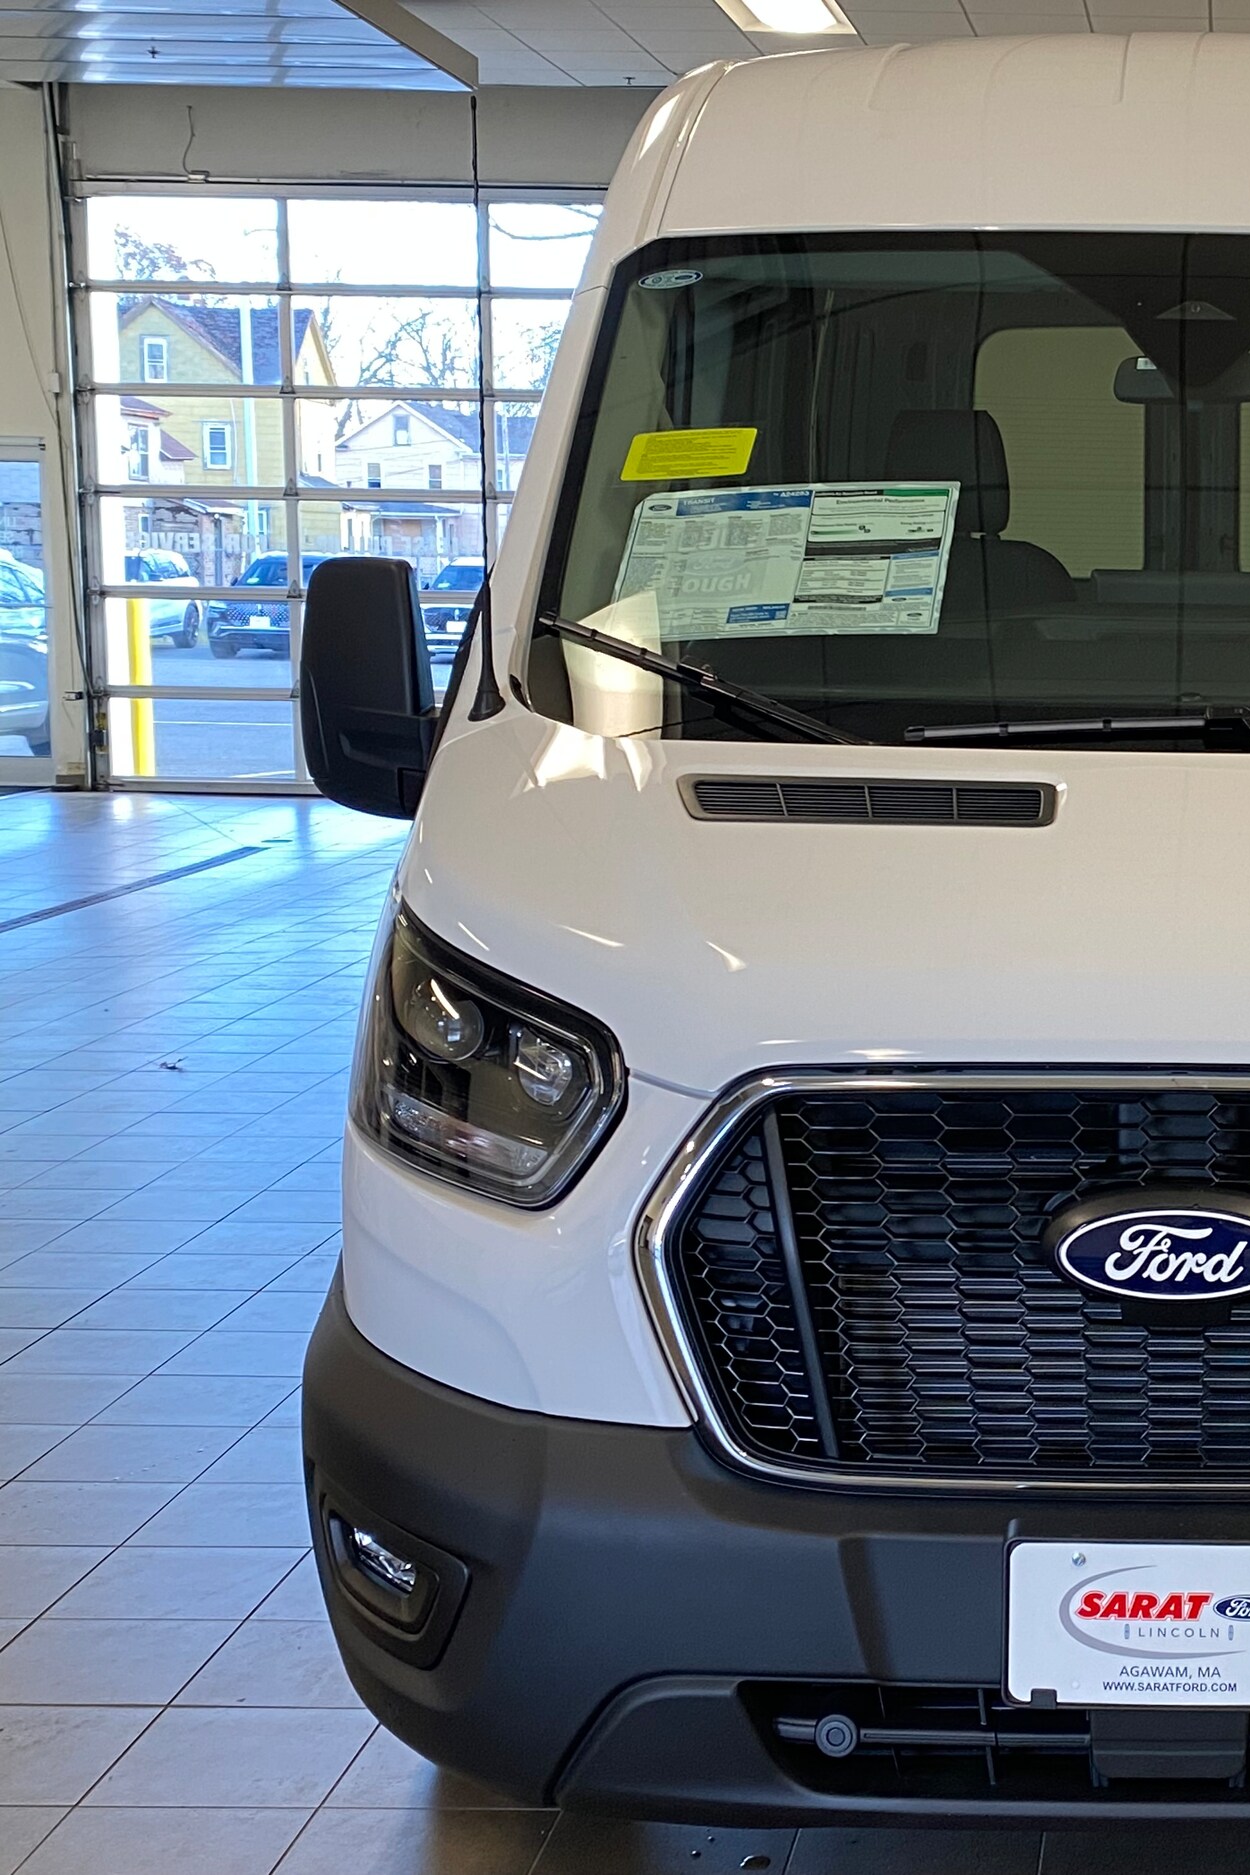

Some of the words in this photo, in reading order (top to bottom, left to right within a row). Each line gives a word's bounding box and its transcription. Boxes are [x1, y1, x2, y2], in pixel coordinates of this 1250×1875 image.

[682, 573, 751, 593] OUGH
[1104, 1223, 1248, 1283] Ford
[1076, 1590, 1214, 1621] SARAT
[1138, 1627, 1221, 1639] LINCOLN
[1119, 1665, 1193, 1680] AGAWAM,
[1197, 1666, 1222, 1678] MA
[1102, 1681, 1238, 1692] WWW.SARATFORD.COM
